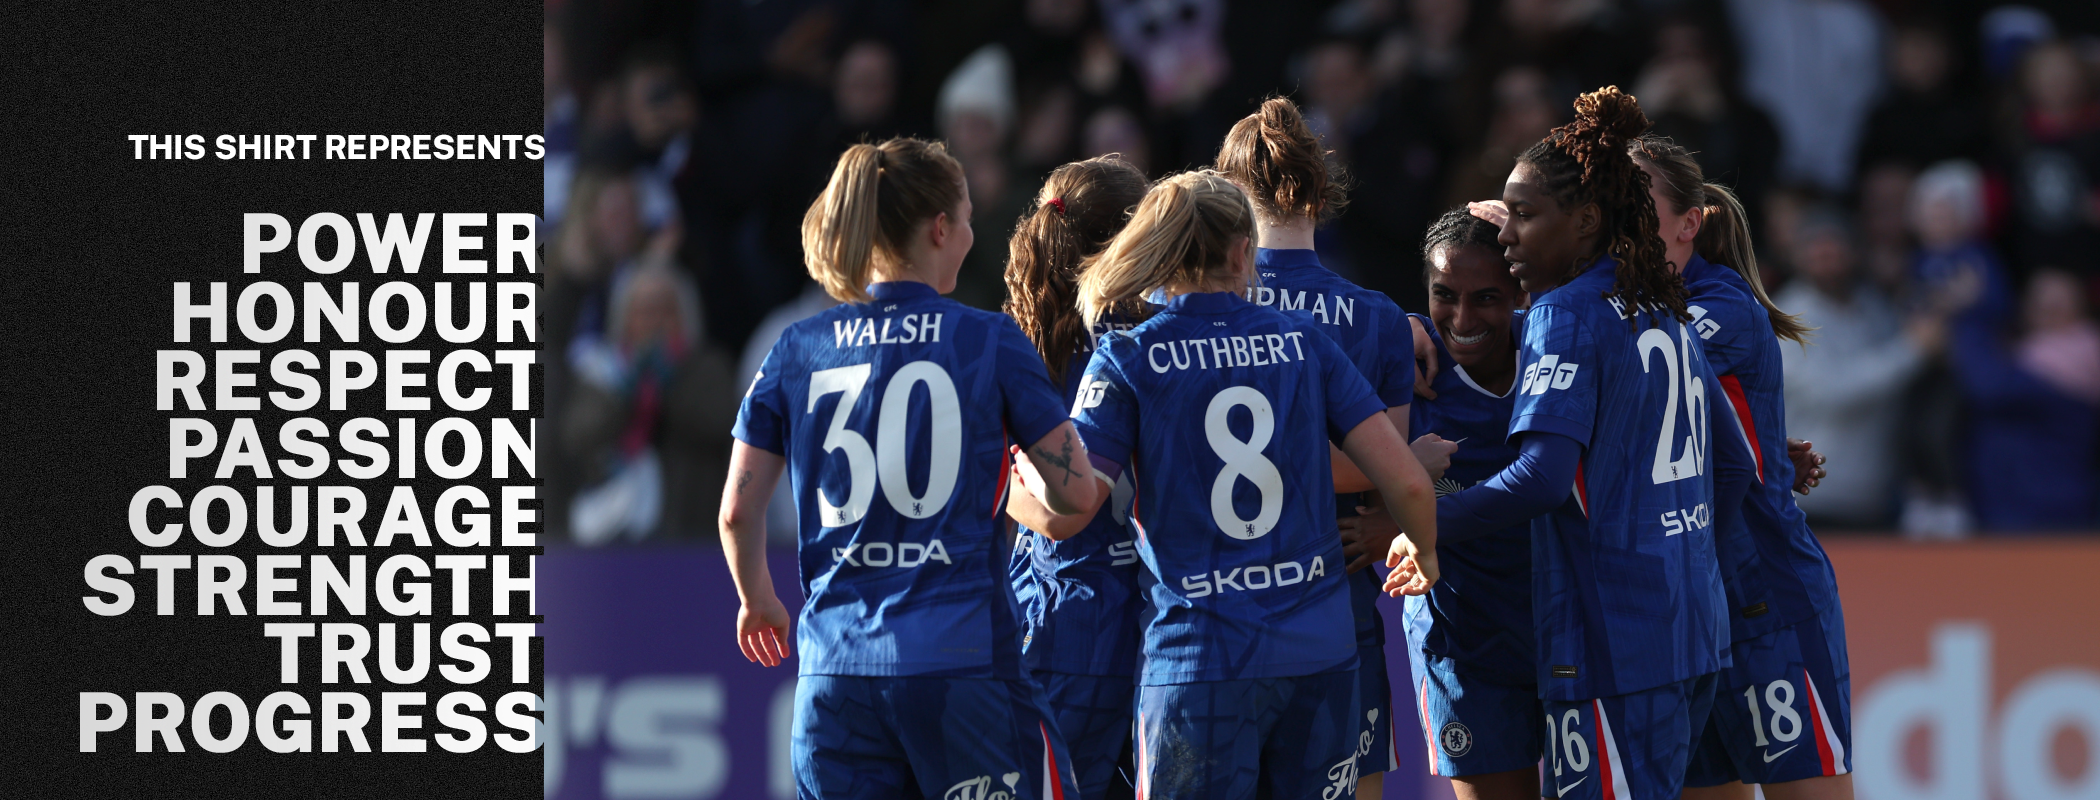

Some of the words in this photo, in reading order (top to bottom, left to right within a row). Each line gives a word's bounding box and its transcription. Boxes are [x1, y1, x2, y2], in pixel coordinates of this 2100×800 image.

[833, 313, 943, 349] WALSH
[1147, 331, 1306, 374] CUTHBERT
[1520, 354, 1579, 395] FPT
[1636, 323, 1706, 484] 26
[806, 360, 962, 528] 30
[1204, 386, 1284, 540] 8
[1181, 556, 1325, 598] SKODA
[1546, 708, 1590, 777] 26
[1744, 679, 1803, 747] 18
